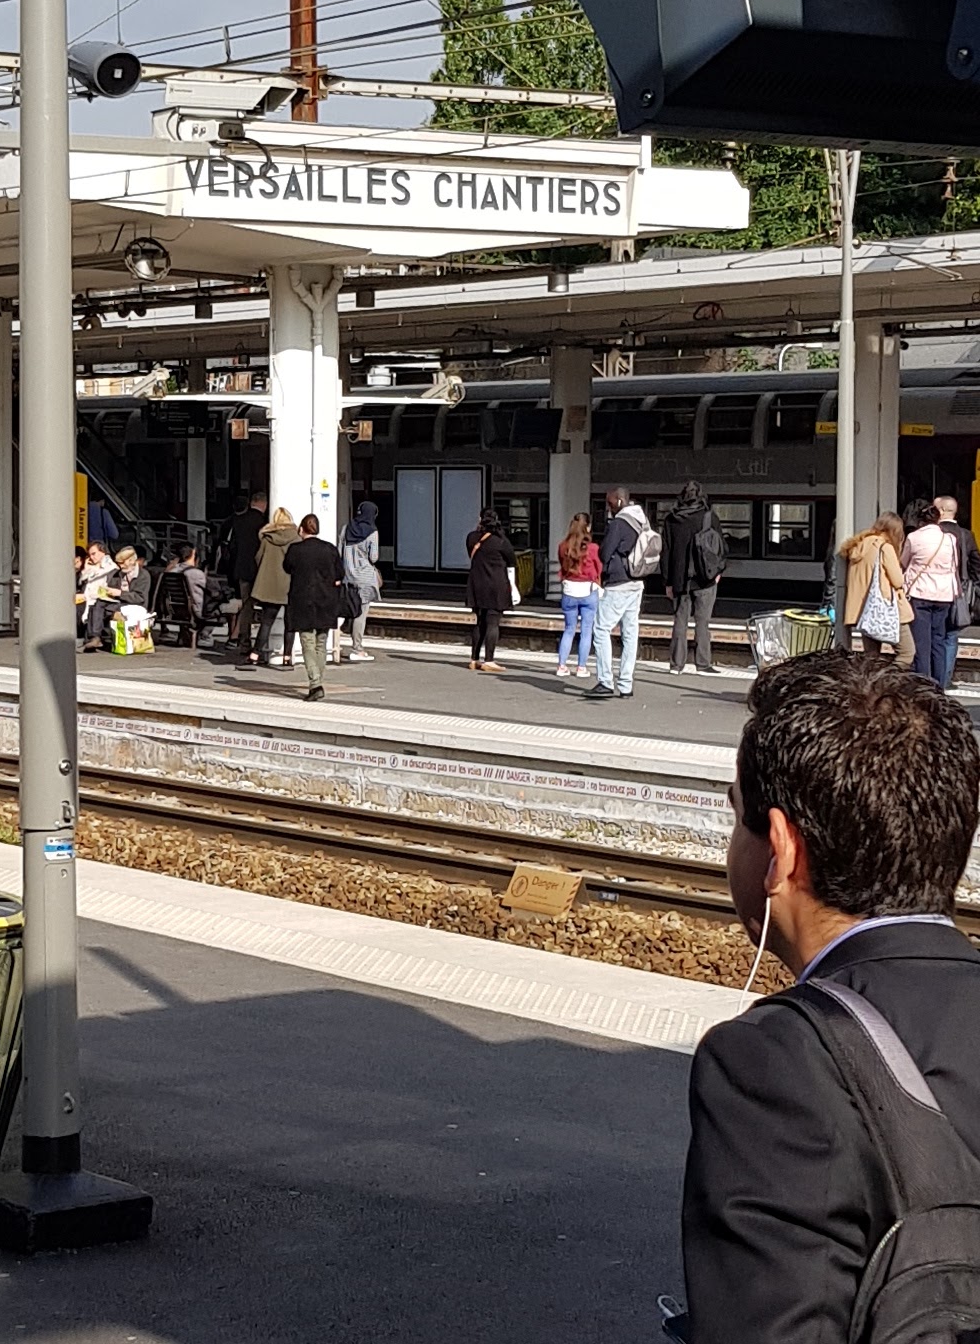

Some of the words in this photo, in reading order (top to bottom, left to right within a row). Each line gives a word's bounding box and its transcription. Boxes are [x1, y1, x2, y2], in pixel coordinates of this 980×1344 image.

[185, 157, 411, 205] VERSAILLES
[433, 172, 621, 216] CHANTIERS
[655, 790, 663, 799] ne
[665, 789, 699, 805] descendez
[700, 796, 712, 807] pas
[713, 798, 724, 808] sur
